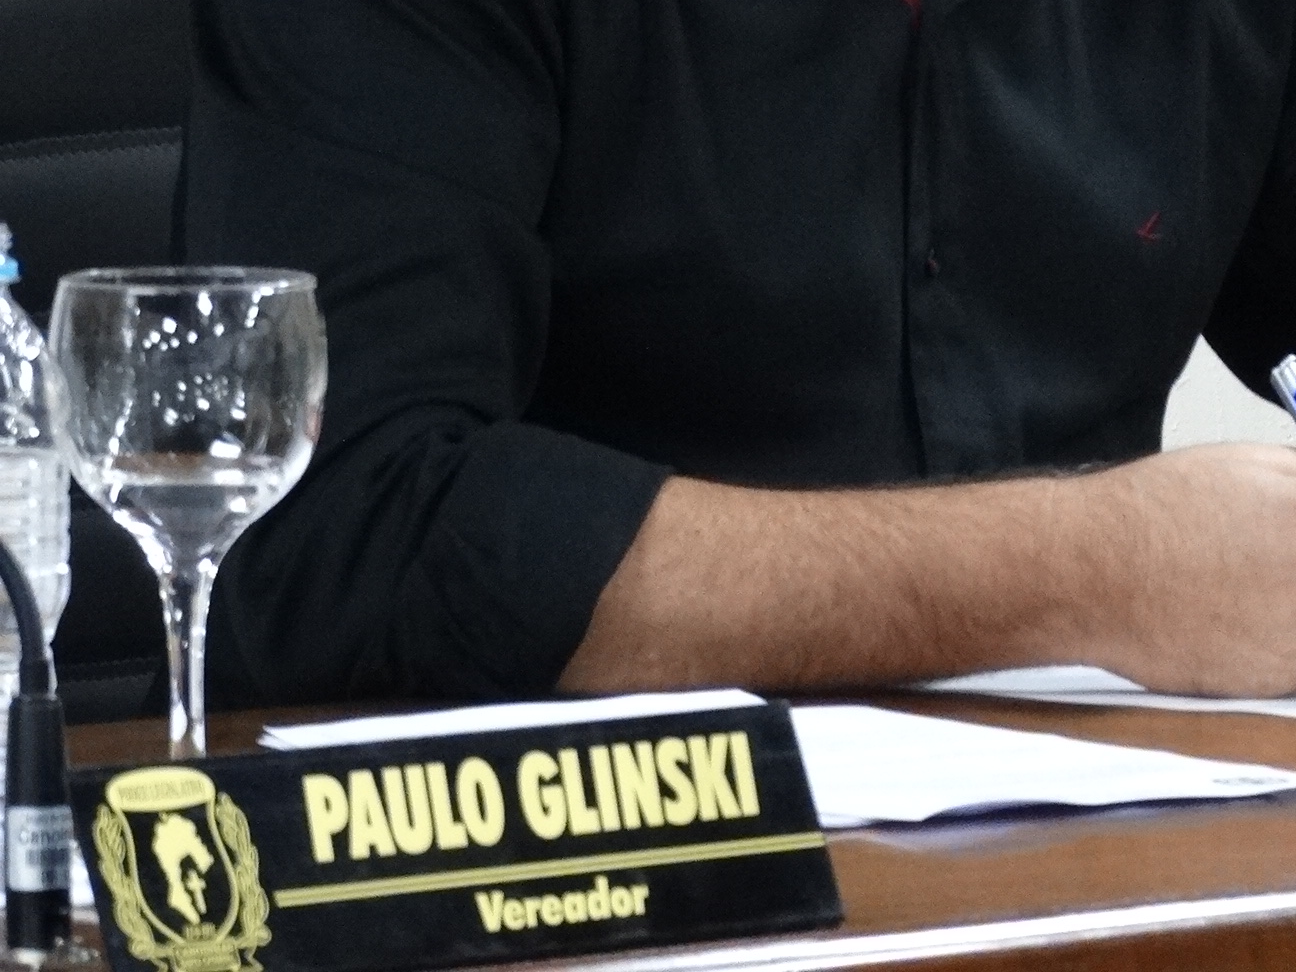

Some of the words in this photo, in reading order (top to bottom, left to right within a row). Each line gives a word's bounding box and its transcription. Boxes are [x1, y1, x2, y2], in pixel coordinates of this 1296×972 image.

[302, 757, 505, 863] PAULO
[517, 731, 760, 839] GLINSKI
[475, 875, 649, 932] Vereador
